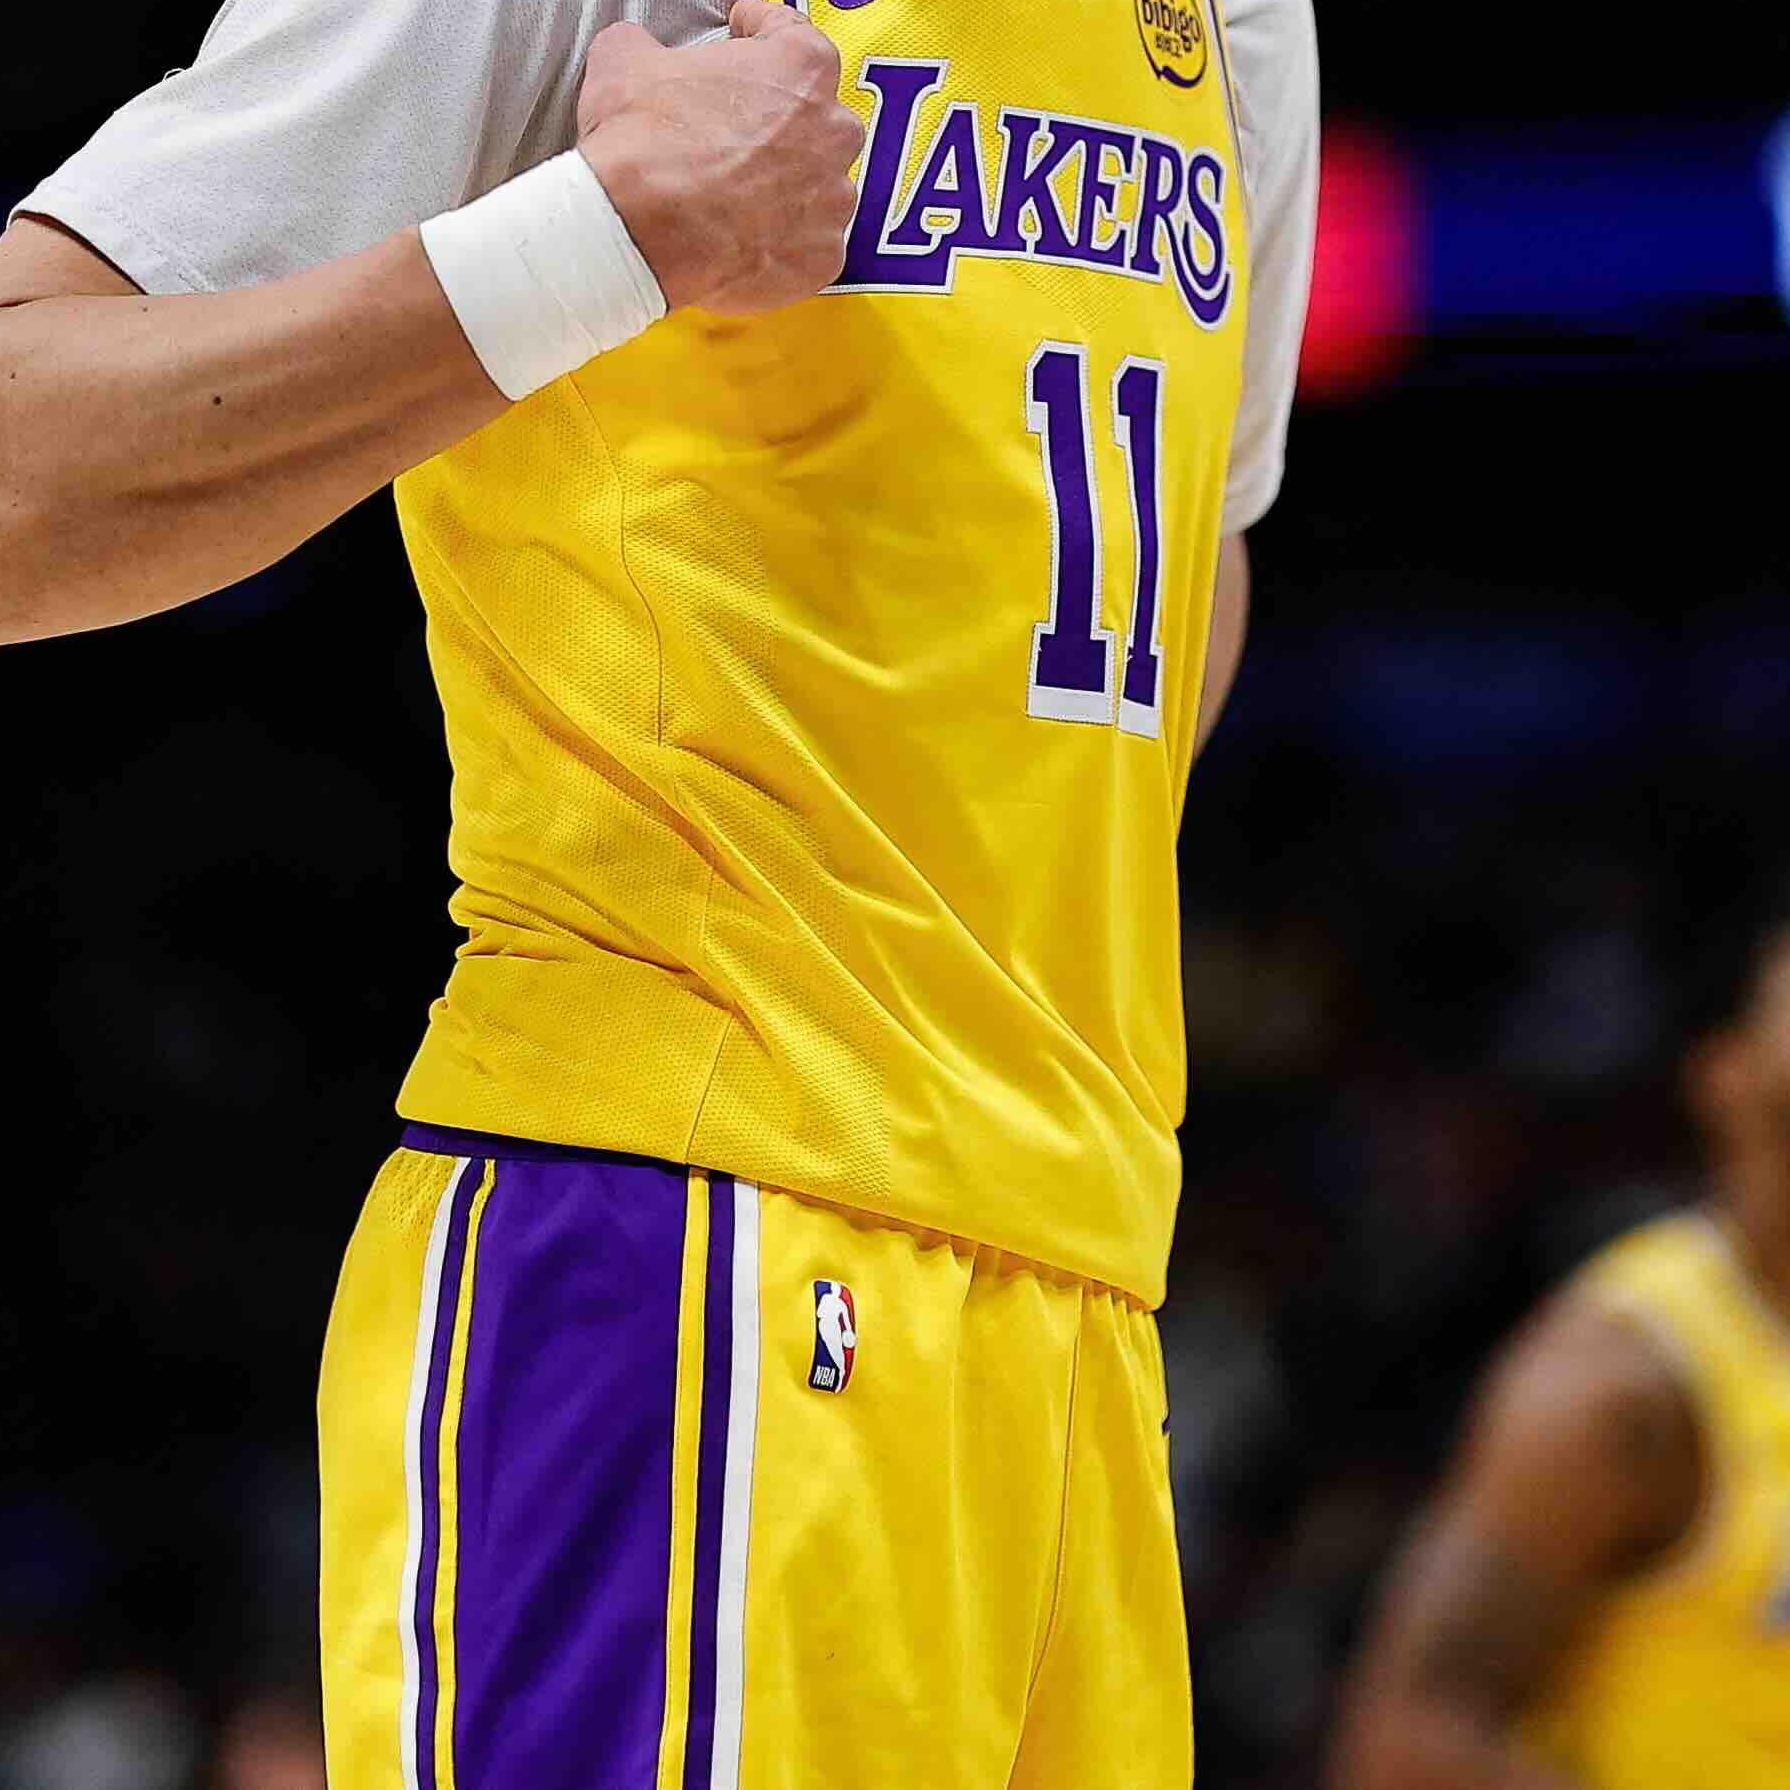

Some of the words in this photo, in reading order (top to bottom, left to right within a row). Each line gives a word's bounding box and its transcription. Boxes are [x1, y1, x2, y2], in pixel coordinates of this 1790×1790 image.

[819, 59, 1230, 329] LAKERS
[1026, 340, 1164, 740] 11
[812, 1365, 836, 1387] NBA
